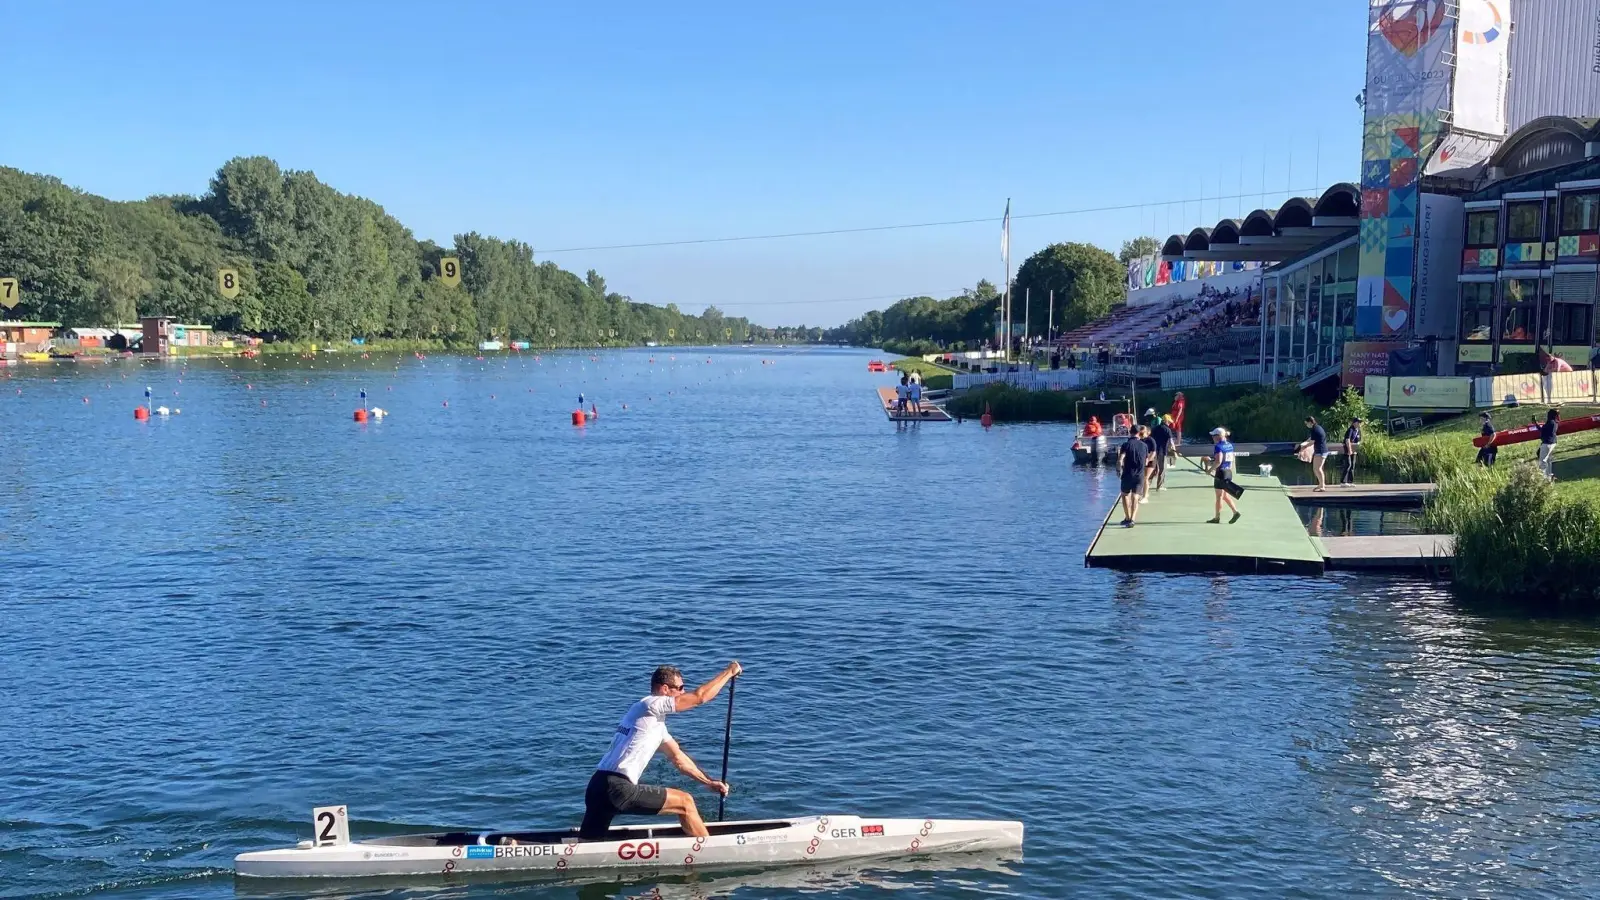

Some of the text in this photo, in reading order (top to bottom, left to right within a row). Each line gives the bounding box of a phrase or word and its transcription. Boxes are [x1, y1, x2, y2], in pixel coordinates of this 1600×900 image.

[445, 262, 456, 278] 9
[224, 273, 235, 289] 8
[2, 281, 14, 299] 7
[317, 811, 337, 841] 2
[831, 828, 857, 838] GER
[495, 845, 559, 858] BRENDEL
[617, 842, 660, 860] GO!
